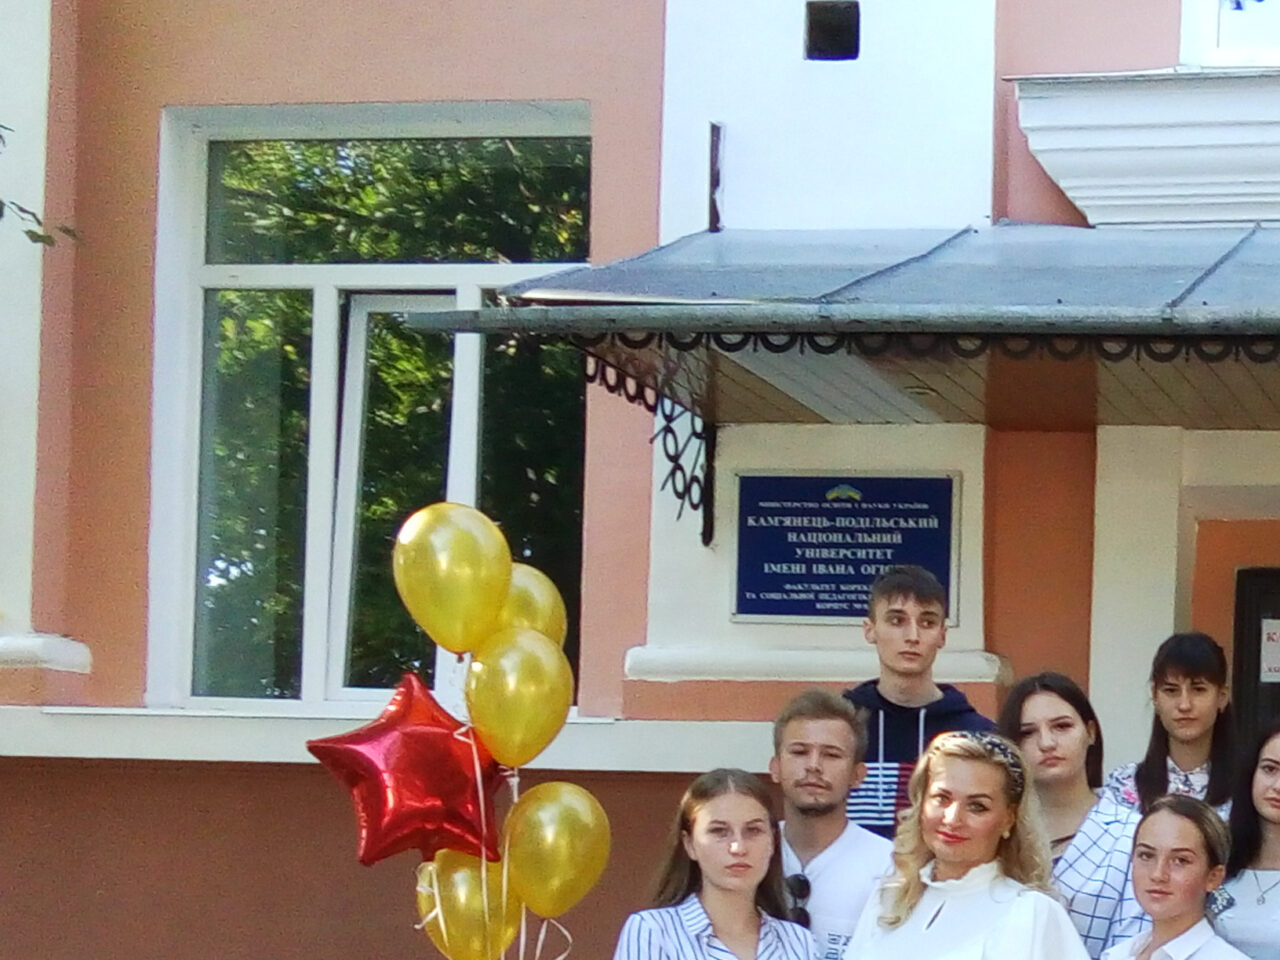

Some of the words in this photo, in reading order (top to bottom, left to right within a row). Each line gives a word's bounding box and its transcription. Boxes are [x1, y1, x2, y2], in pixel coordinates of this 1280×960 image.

[787, 531, 902, 544] НАЦІОНАЛЬНИЙ
[795, 548, 894, 560] УНІВЕРСИТЕТ
[763, 563, 806, 575] ІМЕНІ
[812, 563, 855, 576] ІВАНА
